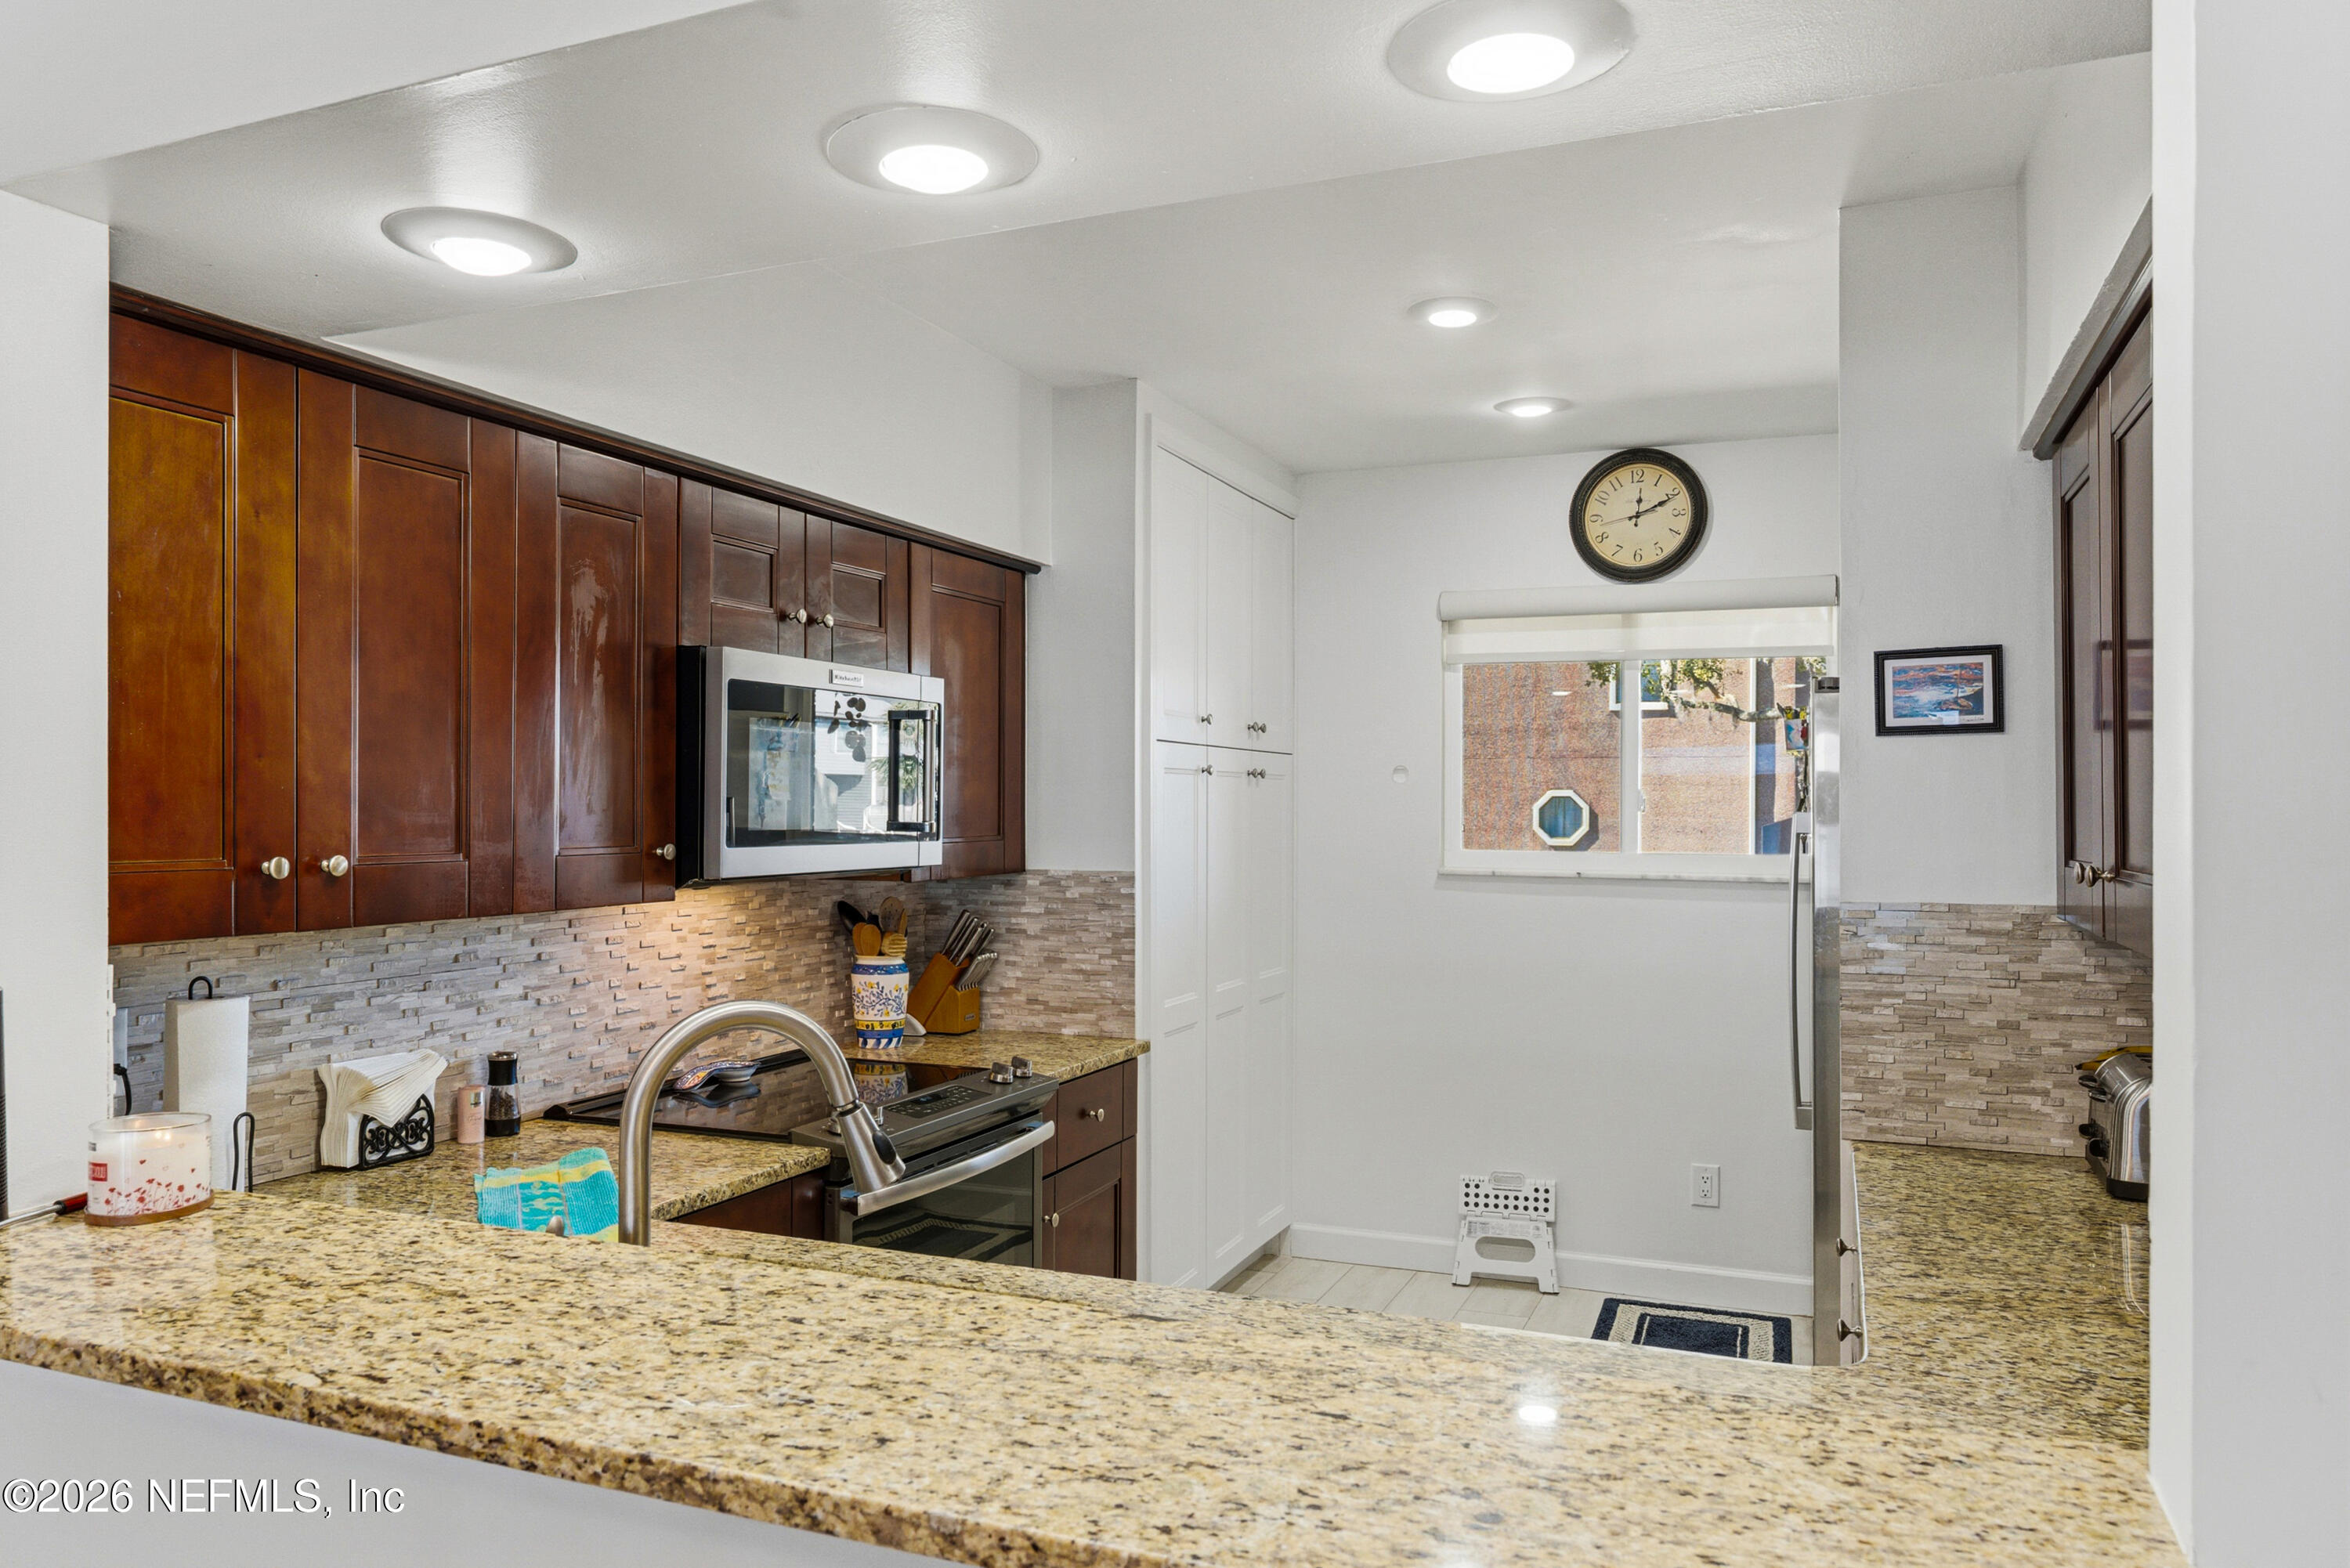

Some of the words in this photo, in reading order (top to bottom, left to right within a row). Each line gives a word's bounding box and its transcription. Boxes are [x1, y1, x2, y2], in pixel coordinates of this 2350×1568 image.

[1630, 468, 1645, 484] 12
[1654, 474, 1663, 487] 1
[1609, 476, 1624, 492] 11
[1595, 490, 1611, 506] 10
[1665, 487, 1681, 500] 2
[1589, 514, 1603, 523] 9
[1672, 508, 1687, 518] 3
[1595, 532, 1610, 544] 8
[1611, 544, 1624, 557] 7
[1633, 548, 1643, 563] 6
[1654, 541, 1664, 557] 5
